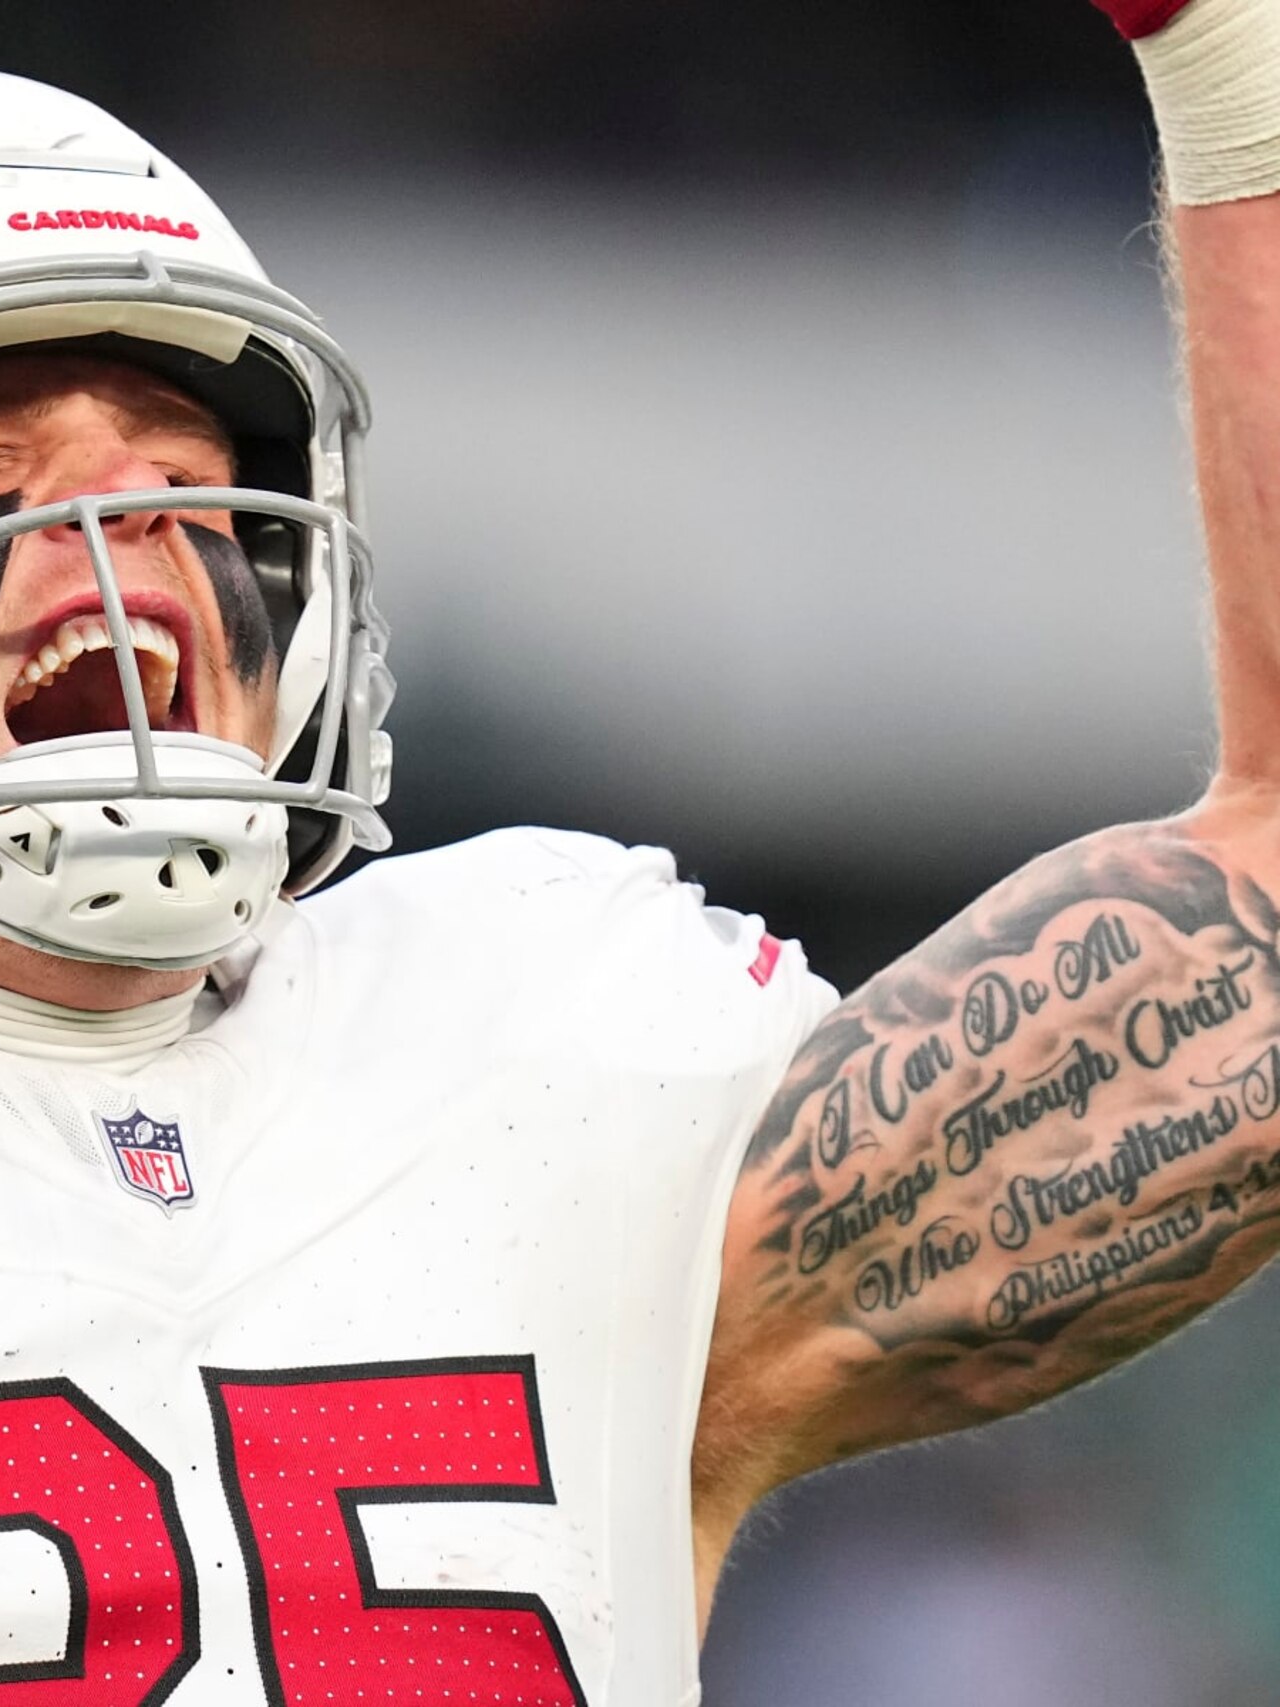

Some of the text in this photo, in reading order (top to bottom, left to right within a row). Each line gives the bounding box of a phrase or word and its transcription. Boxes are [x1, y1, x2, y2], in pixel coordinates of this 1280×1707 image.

[7, 209, 200, 241] CARDINALS
[799, 1158, 937, 1274] Things
[942, 1039, 1119, 1176] Through
[1125, 950, 1255, 1070] Christ
[818, 913, 1141, 1170] I Can Do All
[122, 1148, 188, 1195] NFL
[854, 1095, 1239, 1312] Who Strengthens
[986, 1203, 1204, 1331] Philippians
